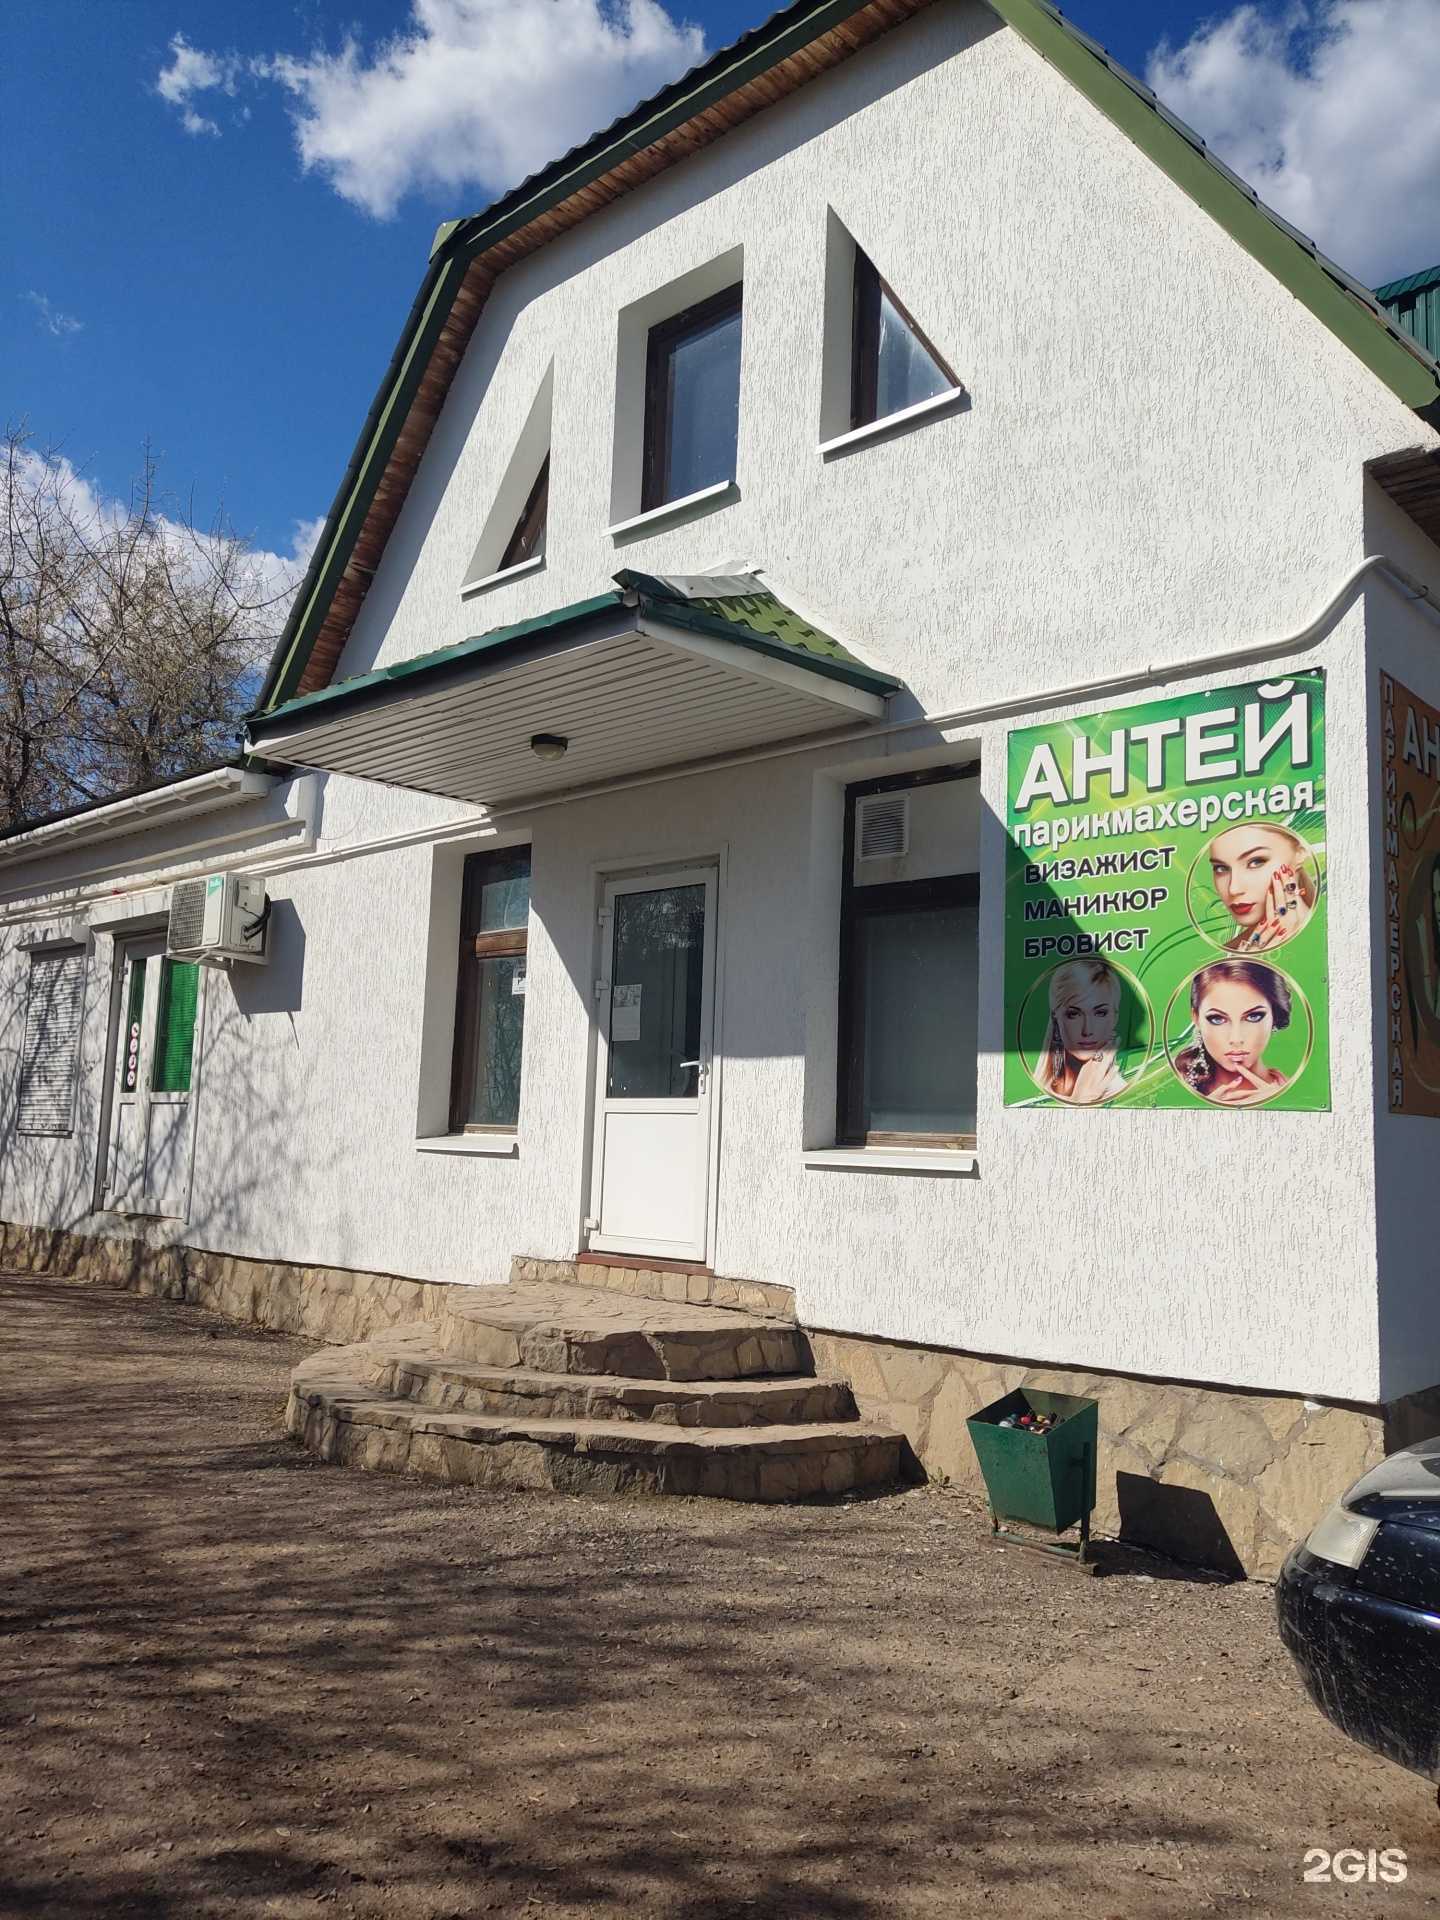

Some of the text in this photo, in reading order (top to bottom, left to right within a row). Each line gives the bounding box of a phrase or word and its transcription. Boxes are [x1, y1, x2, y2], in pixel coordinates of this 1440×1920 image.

[1015, 680, 1308, 809] АНТЕЙ
[1014, 780, 1314, 850] парикмахерская
[1024, 847, 1175, 885] ВИЗАЖИСТ
[1384, 676, 1402, 1105] ПАРИКМАХЕРСКАЯ
[1024, 887, 1168, 921] МАНИКЮР
[1024, 929, 1149, 958] БРОВИСТ
